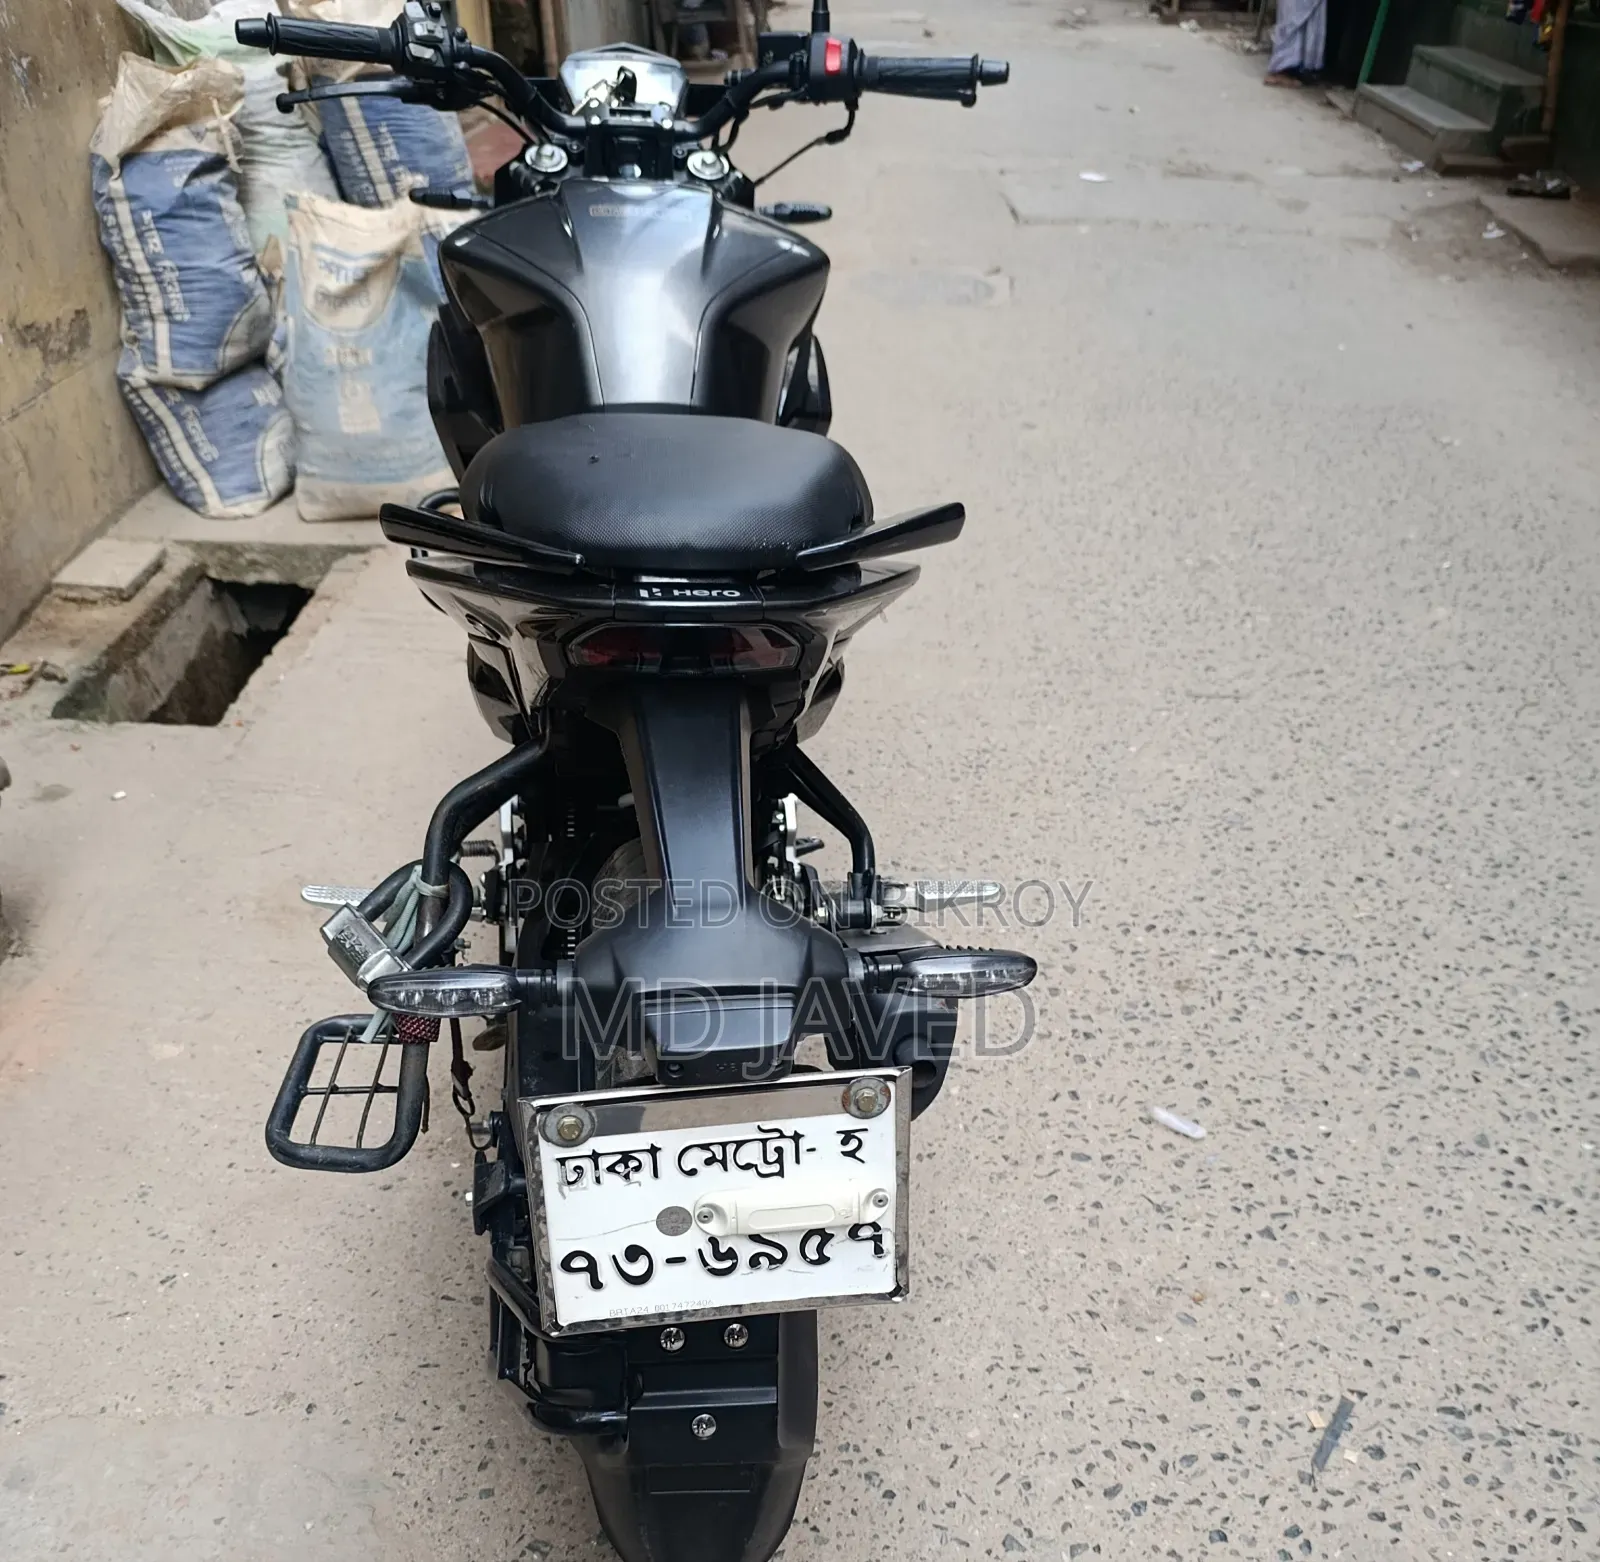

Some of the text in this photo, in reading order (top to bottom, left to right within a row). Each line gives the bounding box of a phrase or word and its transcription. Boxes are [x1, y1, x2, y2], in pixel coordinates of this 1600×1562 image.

[556, 1142, 662, 1187] ঢাকা
[835, 1127, 870, 1164] হ
[560, 1221, 886, 1290] ৭৩-৬৯৫৭
